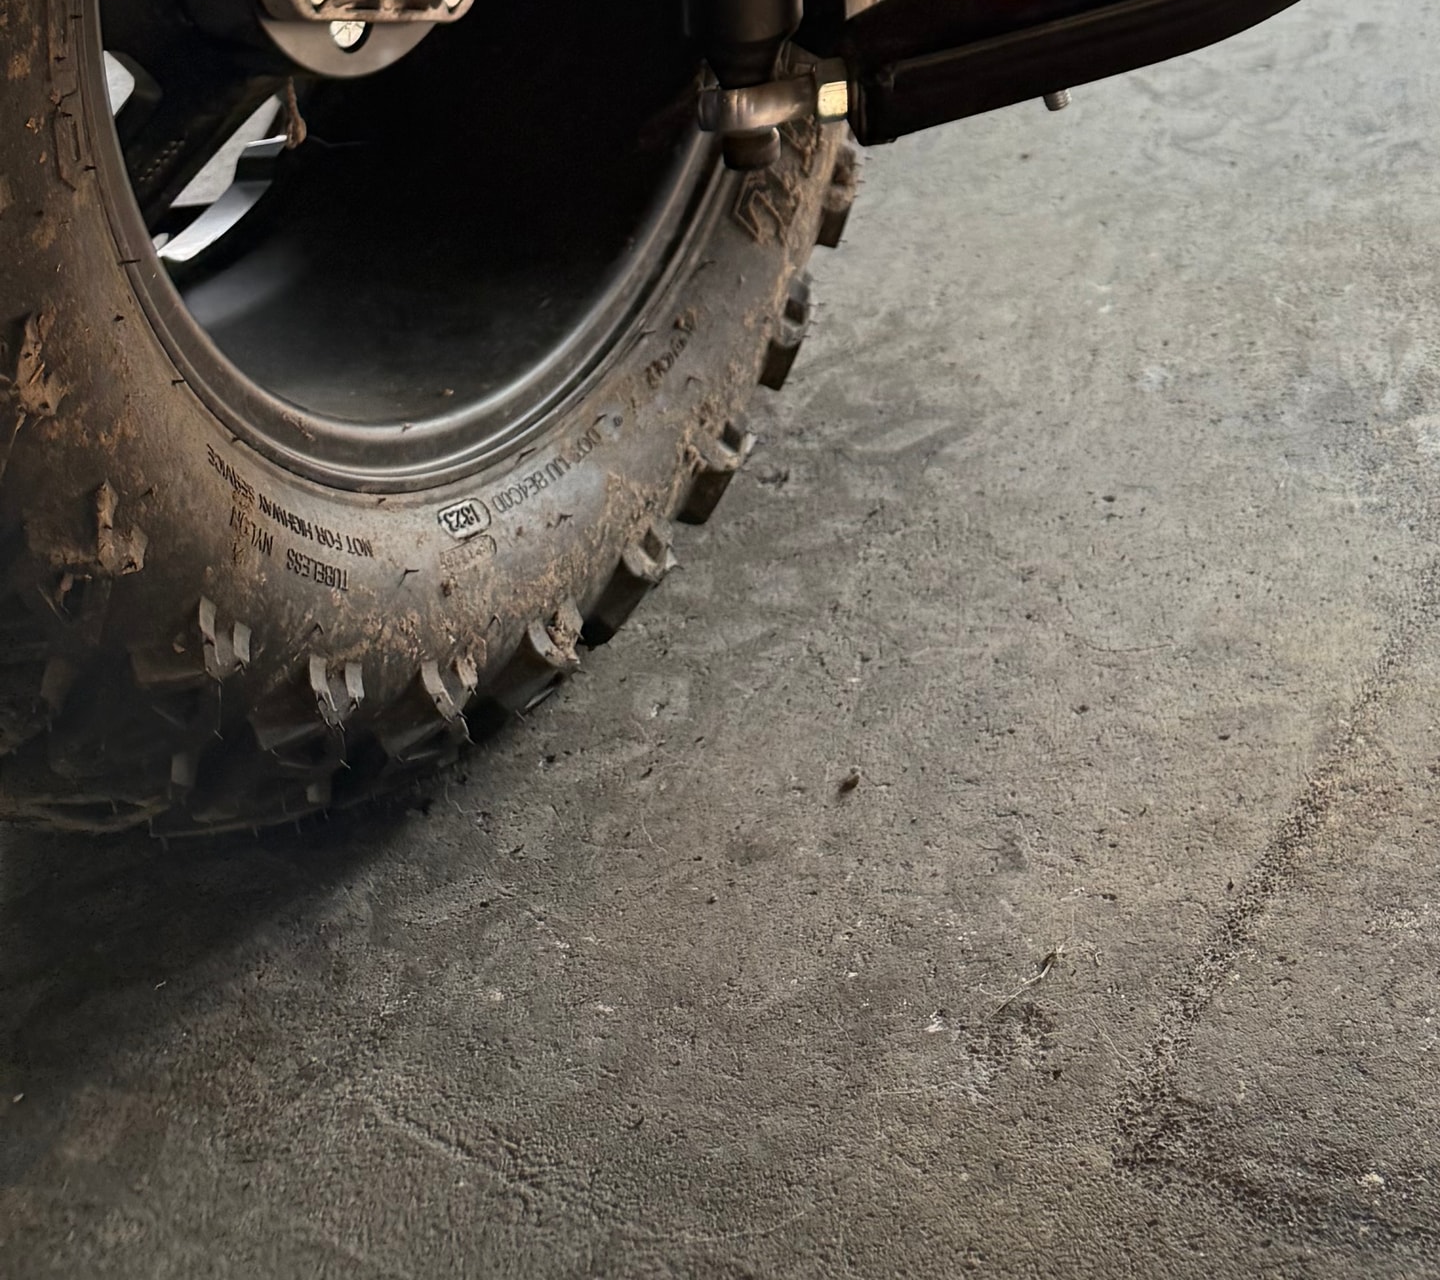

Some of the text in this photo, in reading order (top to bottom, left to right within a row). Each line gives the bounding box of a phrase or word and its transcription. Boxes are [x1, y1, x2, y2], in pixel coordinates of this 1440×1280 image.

[207, 443, 373, 557] NOT FOR HIGHWAY SERVICE
[228, 504, 348, 591] TUBELESS NYLON
